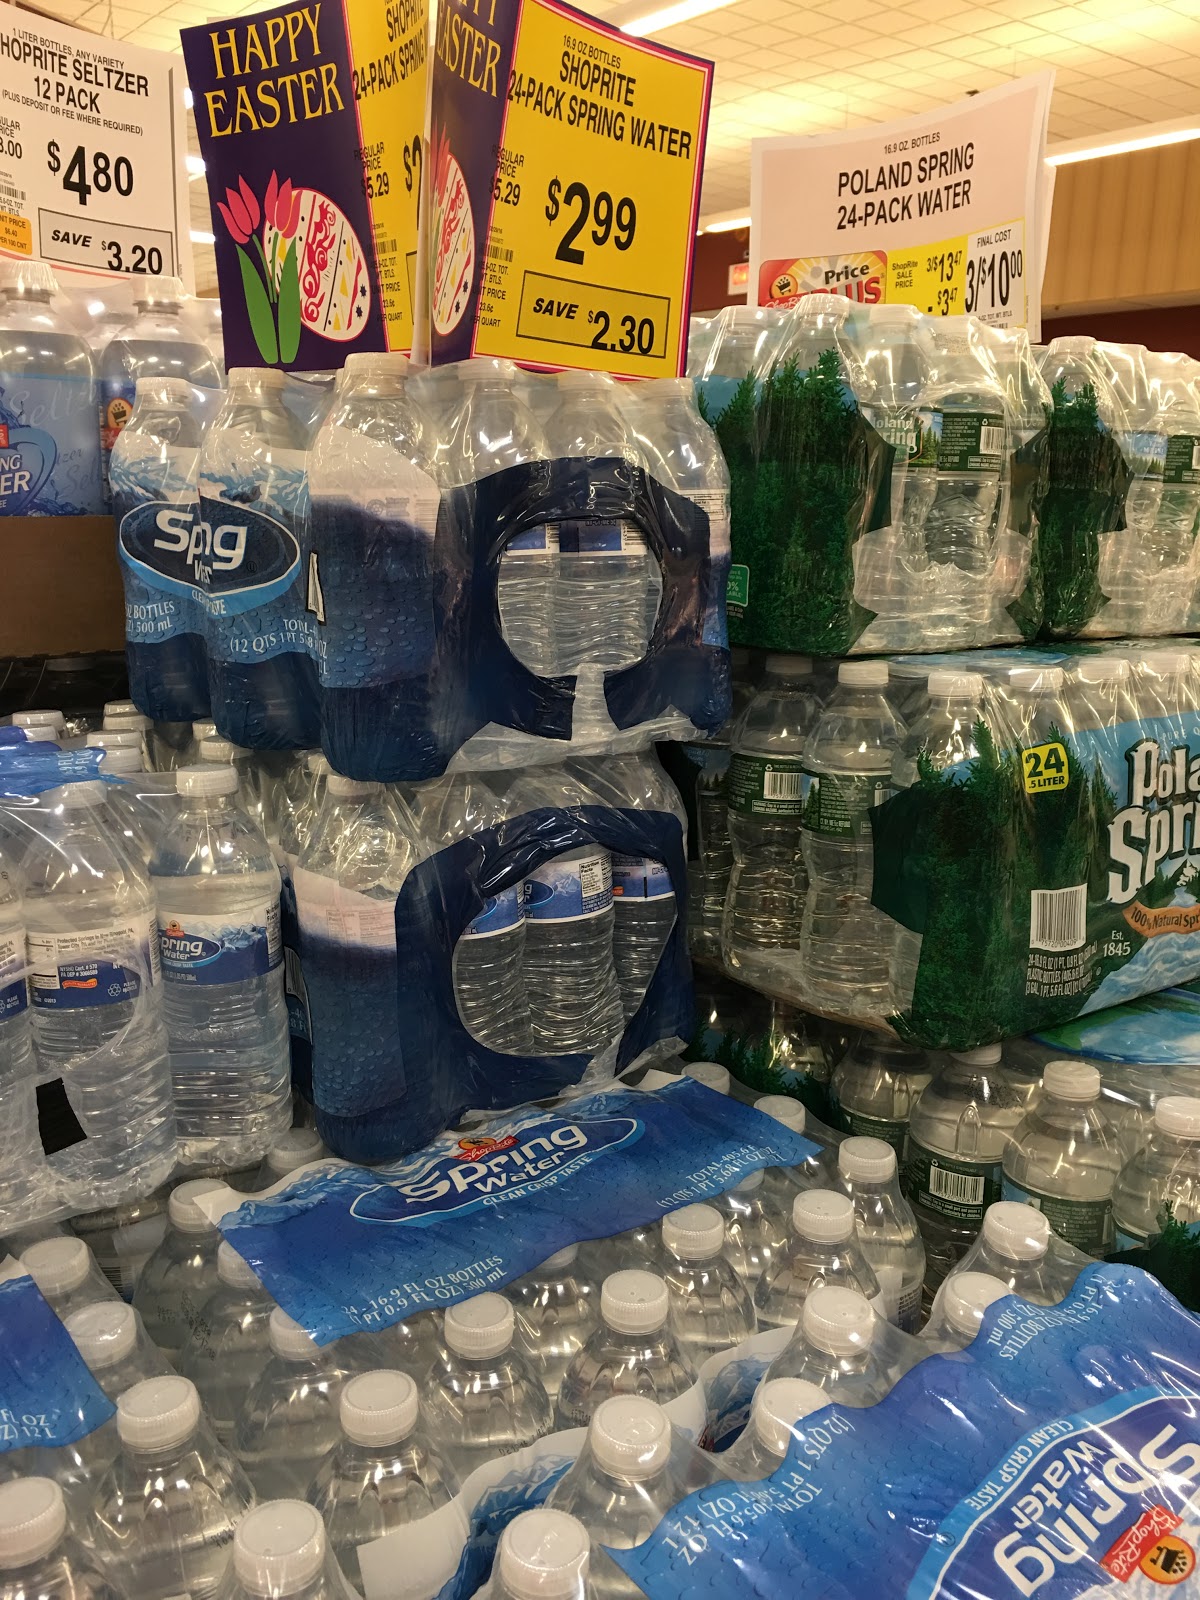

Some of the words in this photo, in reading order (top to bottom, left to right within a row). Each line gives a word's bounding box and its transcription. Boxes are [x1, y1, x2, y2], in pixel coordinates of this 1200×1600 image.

[18, 29, 38, 45] LITER
[75, 48, 92, 60] ANY
[91, 53, 125, 70] VARIETY
[208, 2, 324, 80] HAPPY
[563, 34, 576, 50] 16.9
[577, 41, 588, 54] OZ
[588, 44, 621, 69] BOTTLES
[0, 33, 67, 75] HOPRITE
[73, 59, 149, 97] SELTZER
[353, 50, 399, 100] 24-PACK
[559, 50, 637, 107] SHOPRITE
[34, 76, 51, 100] 12
[56, 82, 101, 114] PACK
[203, 62, 345, 138] EASTER
[21, 95, 49, 112] DEPOSIT
[50, 105, 61, 115] OR
[62, 108, 75, 120] FEE
[76, 113, 102, 127] WHERE
[103, 119, 143, 136] REQUIRED)
[507, 69, 566, 123] 24-PACK
[567, 98, 625, 142] SPRING
[631, 114, 692, 160] WATER
[884, 142, 898, 155] 16.9
[898, 139, 910, 152] OZ.
[911, 131, 941, 149] BOTTLES
[362, 157, 382, 171] PRICE
[496, 160, 517, 178] PRICE
[837, 160, 912, 197] POLAND
[917, 141, 975, 182] SPRING
[837, 192, 912, 230] 24-PACK
[917, 178, 971, 218] WATER
[51, 229, 92, 248] SAVE
[977, 235, 993, 248] FINAL
[995, 229, 1012, 244] COST
[824, 264, 870, 285] Price
[892, 259, 918, 271] ShopRite
[897, 270, 912, 279] SALE
[386, 281, 401, 292] PRICE
[487, 287, 507, 300] PRICE
[811, 276, 882, 305] US
[895, 280, 913, 288] PRICE
[388, 311, 403, 321] QUART
[481, 316, 501, 328] QUART
[533, 297, 580, 320] SAVE
[587, 309, 655, 355] $2.30
[883, 430, 918, 453] ring
[133, 600, 175, 620] BOTTLES
[135, 621, 154, 633] 500
[157, 616, 173, 632] mL
[230, 637, 248, 653] (12
[253, 634, 277, 654] QTS
[287, 632, 296, 643] PT
[1025, 747, 1065, 778] 24
[1130, 741, 1200, 806] Pola
[1028, 780, 1037, 789] .5
[1037, 776, 1066, 787] LITER
[1151, 914, 1182, 929] Natural
[161, 937, 203, 956] pring
[1111, 930, 1124, 940] Est.
[164, 950, 190, 960] Water
[1102, 941, 1131, 957] 1845
[398, 1126, 588, 1204] Spring
[474, 1152, 565, 1193] Water
[483, 1189, 526, 1206] CLEAN
[528, 1176, 559, 1191] CRISP
[559, 1156, 593, 1177] TASTE
[672, 1188, 694, 1201] QTS
[698, 1180, 715, 1191] PT
[369, 1289, 400, 1309] 16.9
[403, 1283, 424, 1294] FL
[424, 1276, 449, 1289] OZ
[447, 1255, 503, 1284] BOTTLES
[363, 1310, 381, 1325] PT
[384, 1298, 408, 1316] 0.9
[411, 1292, 434, 1304] FL
[434, 1284, 465, 1300] OZ)
[487, 1266, 507, 1284] mL
[987, 1327, 1002, 1346] mL
[1080, 1286, 1098, 1302] PT
[999, 1319, 1045, 1361] BOTTLES
[1077, 1302, 1104, 1321] 16.9
[0, 1423, 18, 1440] Z)
[21, 1426, 42, 1438] 12
[45, 1427, 57, 1439] L
[22, 1414, 50, 1426] OZ
[823, 1413, 856, 1435] (12
[803, 1426, 833, 1461] QTS
[1027, 1420, 1074, 1449] CLEAN
[998, 1445, 1033, 1483] CRISP
[781, 1472, 805, 1493] PT
[1010, 1440, 1106, 1529] Water
[965, 1480, 1004, 1511] TASTE
[697, 1497, 736, 1519] OZ)
[994, 1423, 1200, 1598] Spring
[673, 1515, 700, 1536] 12
[706, 1520, 733, 1538] FL
[662, 1537, 679, 1549] L
[1111, 1505, 1178, 1577] ShopRite
